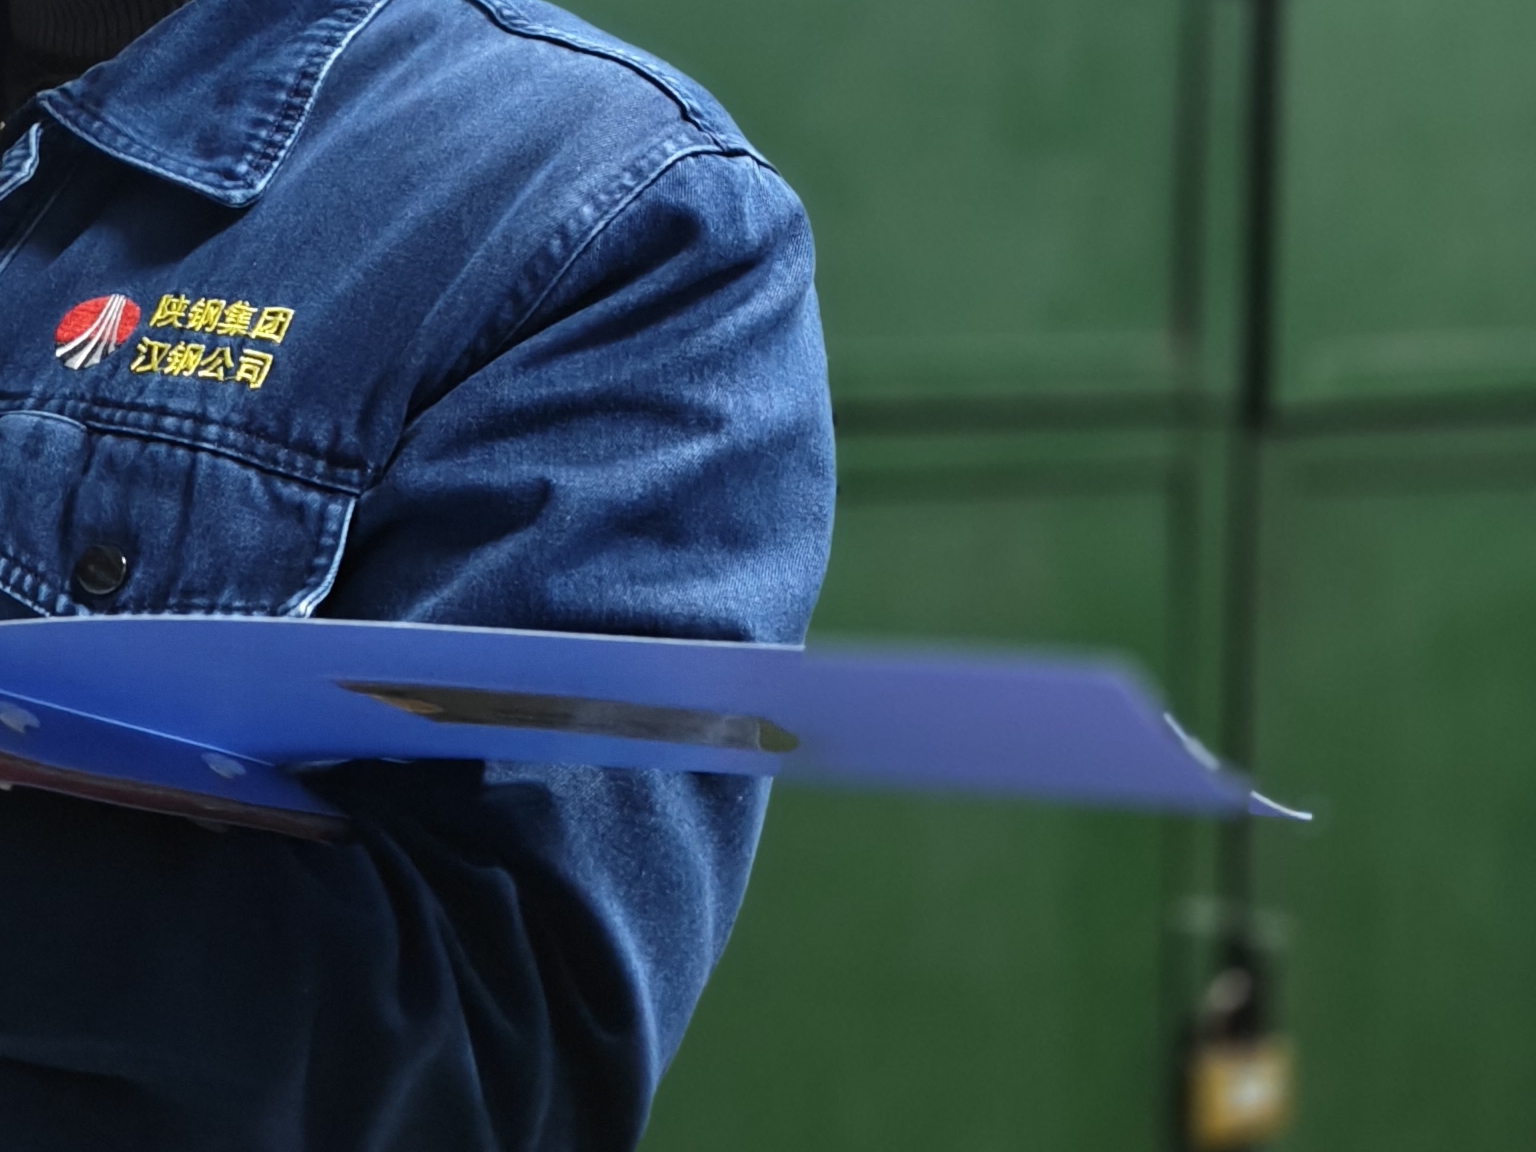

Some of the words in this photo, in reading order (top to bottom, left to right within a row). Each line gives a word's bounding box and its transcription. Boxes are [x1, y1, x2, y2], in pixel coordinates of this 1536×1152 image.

[150, 294, 295, 344] 陕钢集团
[131, 337, 274, 389] 汉钢公司
